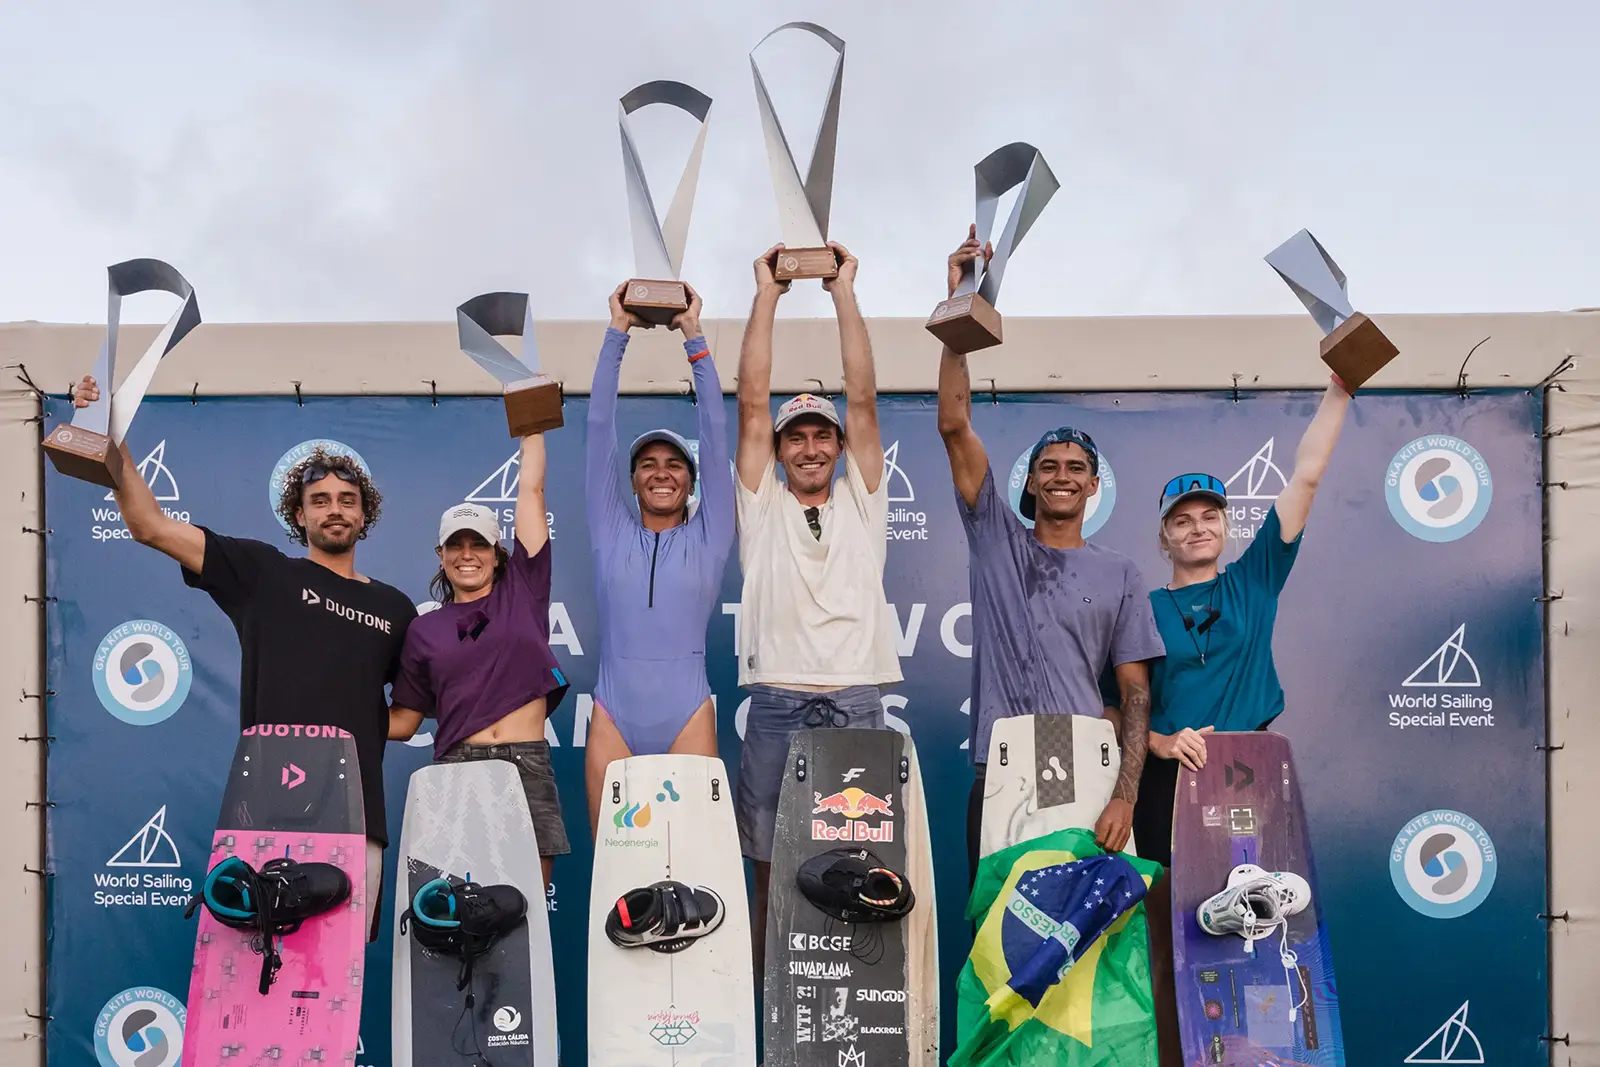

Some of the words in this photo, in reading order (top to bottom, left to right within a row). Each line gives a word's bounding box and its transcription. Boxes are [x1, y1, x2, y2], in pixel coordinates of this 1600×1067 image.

[285, 445, 309, 464] KITE
[1388, 462, 1402, 487] GKA
[1400, 440, 1425, 460] KITE
[1427, 438, 1471, 456] WORLD
[1471, 454, 1489, 486] TOUR
[1012, 464, 1026, 488] GKA
[92, 508, 121, 521] Wor
[888, 508, 926, 525] ailing
[1229, 524, 1254, 538] cial
[326, 598, 392, 634] DUOTONE
[96, 647, 109, 671] GKA
[106, 625, 129, 645] KITE
[132, 623, 172, 640] WORLD
[172, 640, 189, 670] TOUR
[1388, 694, 1436, 708] World
[1441, 694, 1492, 712] Sailing
[1389, 712, 1445, 729] Special
[1450, 713, 1494, 726] Event
[812, 820, 853, 841] Red
[854, 821, 893, 842] Bull
[1393, 838, 1408, 862] GKA
[1405, 816, 1430, 836] KITE
[1432, 813, 1476, 832] WORLD
[1476, 830, 1493, 862] TOUR
[605, 838, 658, 849] Neoenergia
[94, 874, 138, 888] World
[143, 874, 192, 891] Sailing
[94, 891, 146, 908] Special
[809, 935, 852, 951] BCGE
[789, 961, 851, 976] SILVAPLANA
[856, 989, 906, 1002] SUNGOD
[97, 1012, 111, 1036] GKA
[108, 992, 132, 1011] KITE
[135, 990, 176, 1008] WORLD
[797, 1004, 811, 1043] WTF
